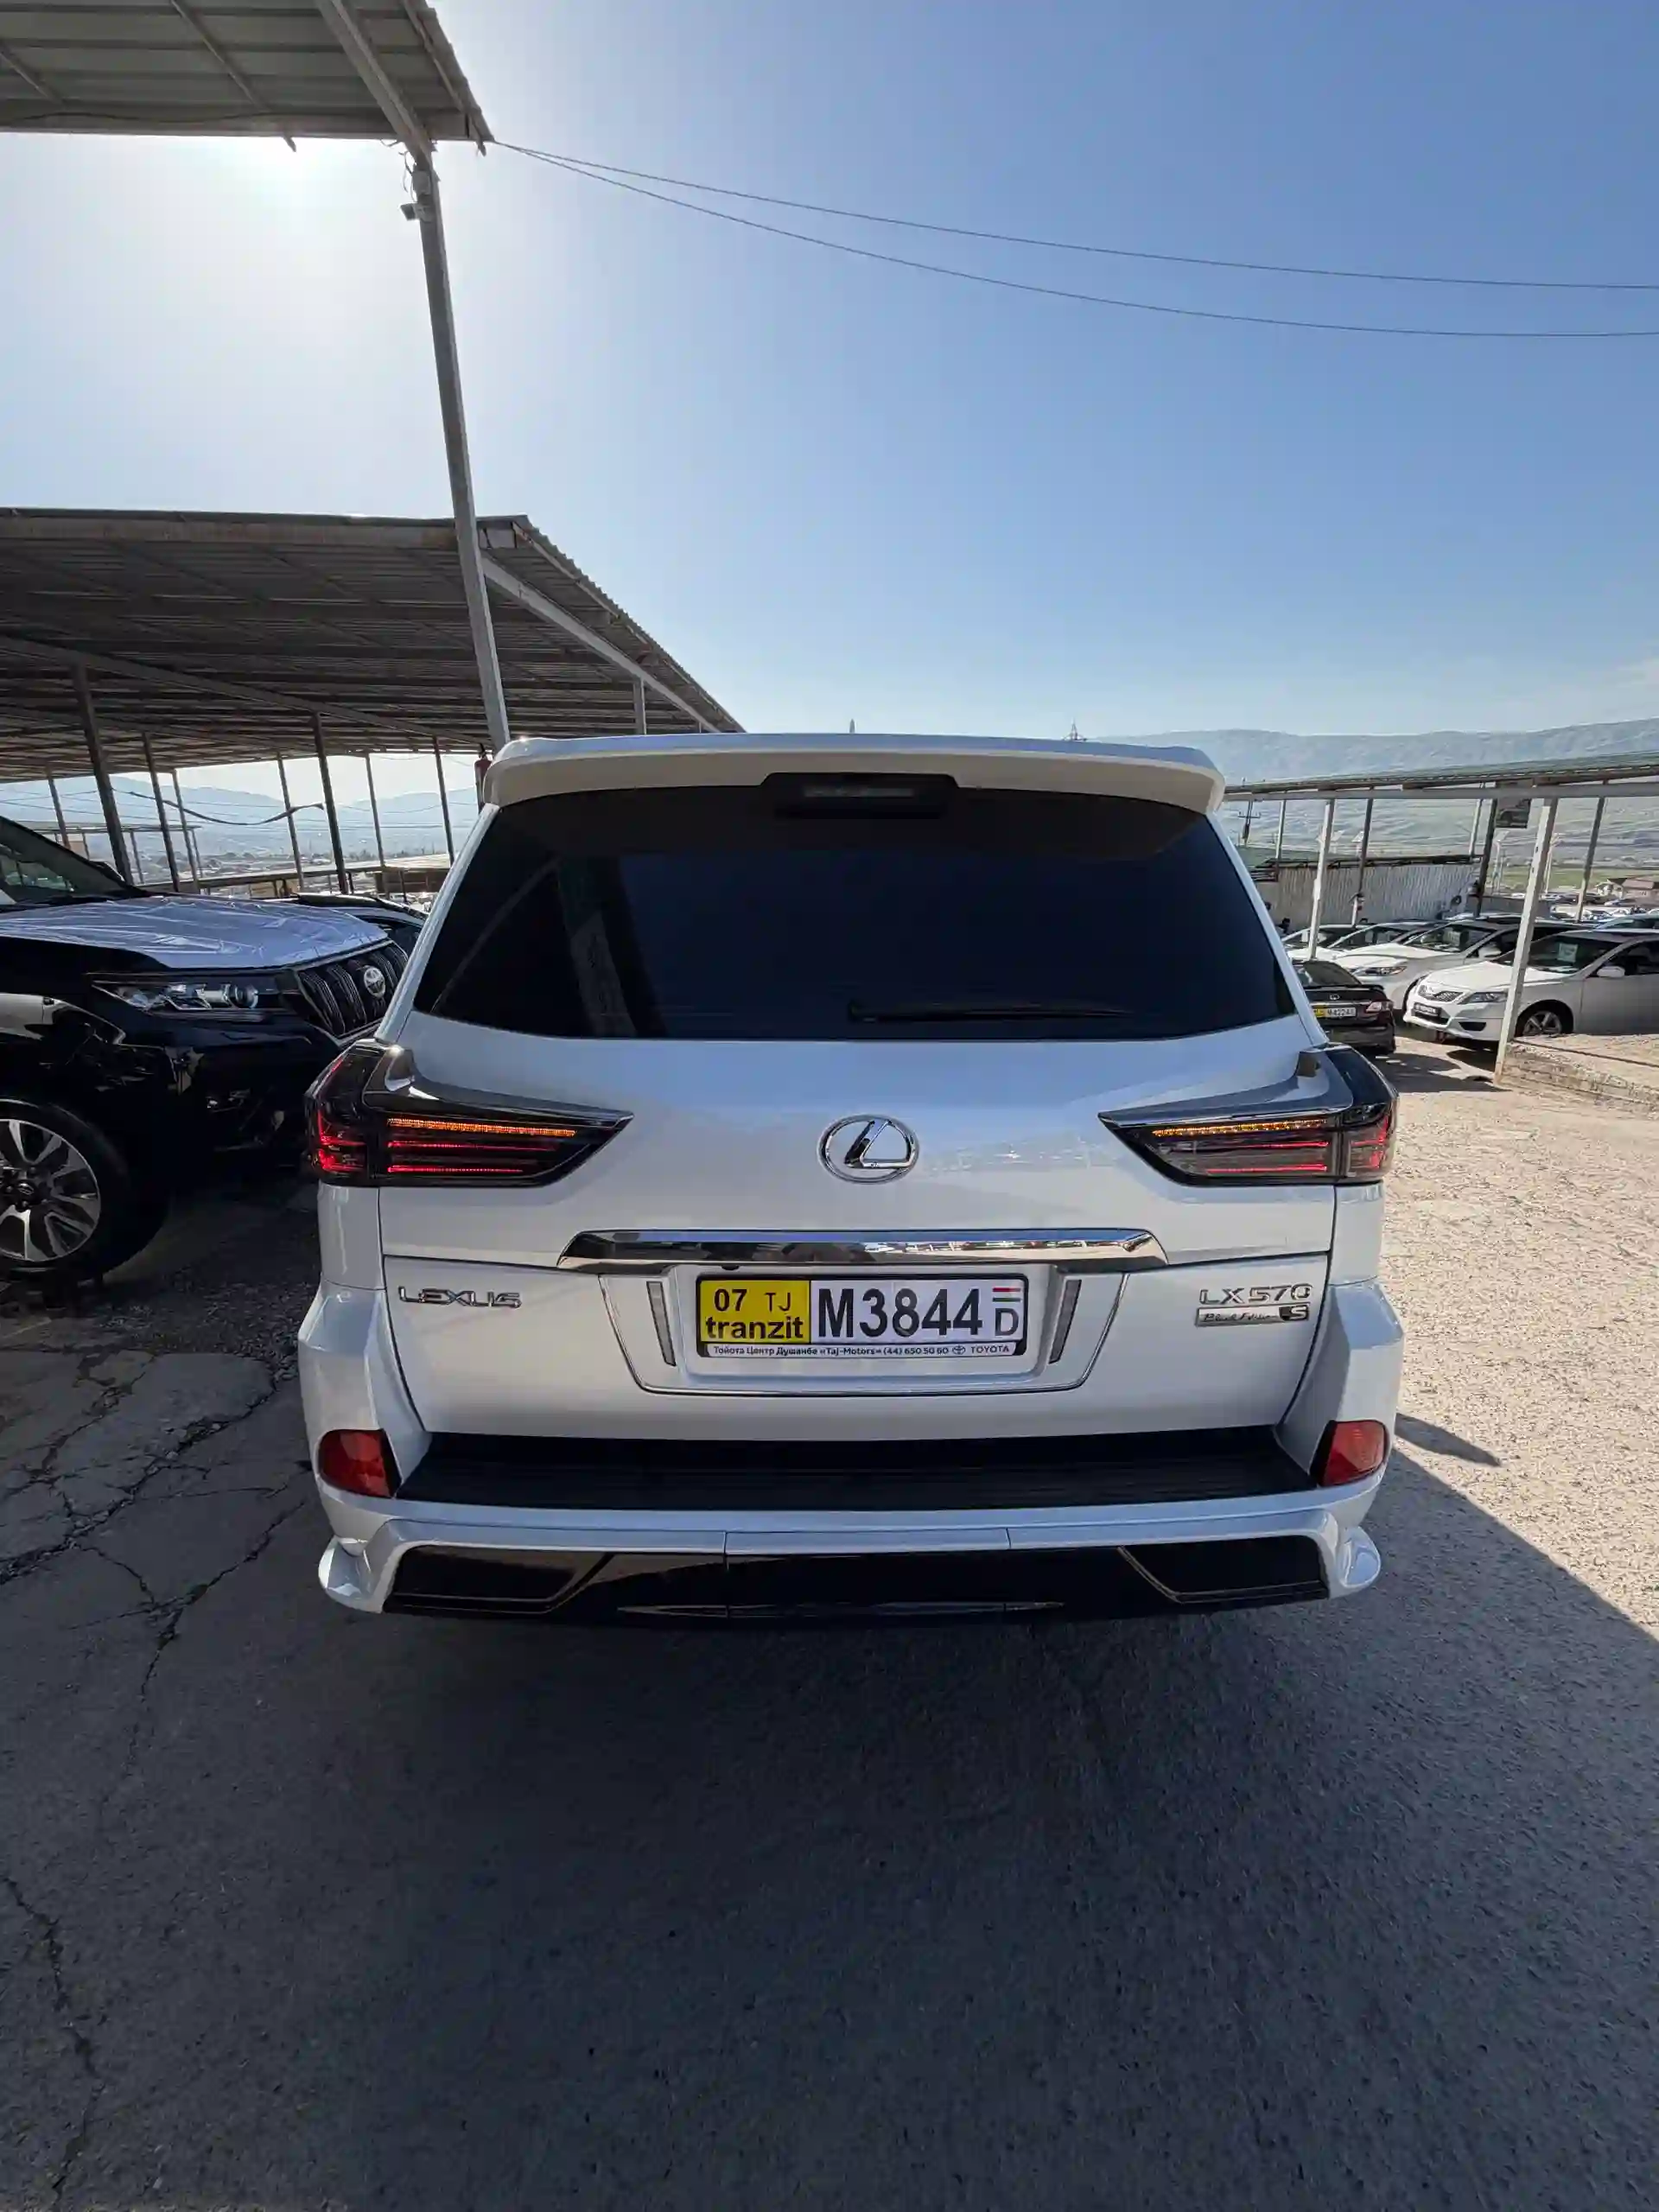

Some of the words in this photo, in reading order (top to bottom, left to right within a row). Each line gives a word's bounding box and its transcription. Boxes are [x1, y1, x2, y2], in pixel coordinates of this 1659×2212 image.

[398, 1285, 521, 1308] LEXUS
[714, 1288, 747, 1312] 07
[764, 1292, 791, 1312] TJ
[1198, 1287, 1245, 1305] LX
[1249, 1283, 1313, 1303] 570
[817, 1287, 983, 1338] M3844
[995, 1307, 1019, 1336] D
[705, 1316, 804, 1338] tranzit
[714, 1345, 745, 1355] Тойота
[747, 1346, 774, 1357] Центр
[777, 1346, 817, 1356] Душанбе
[883, 1346, 902, 1356] (44)
[970, 1345, 1009, 1354] TOYOTA
